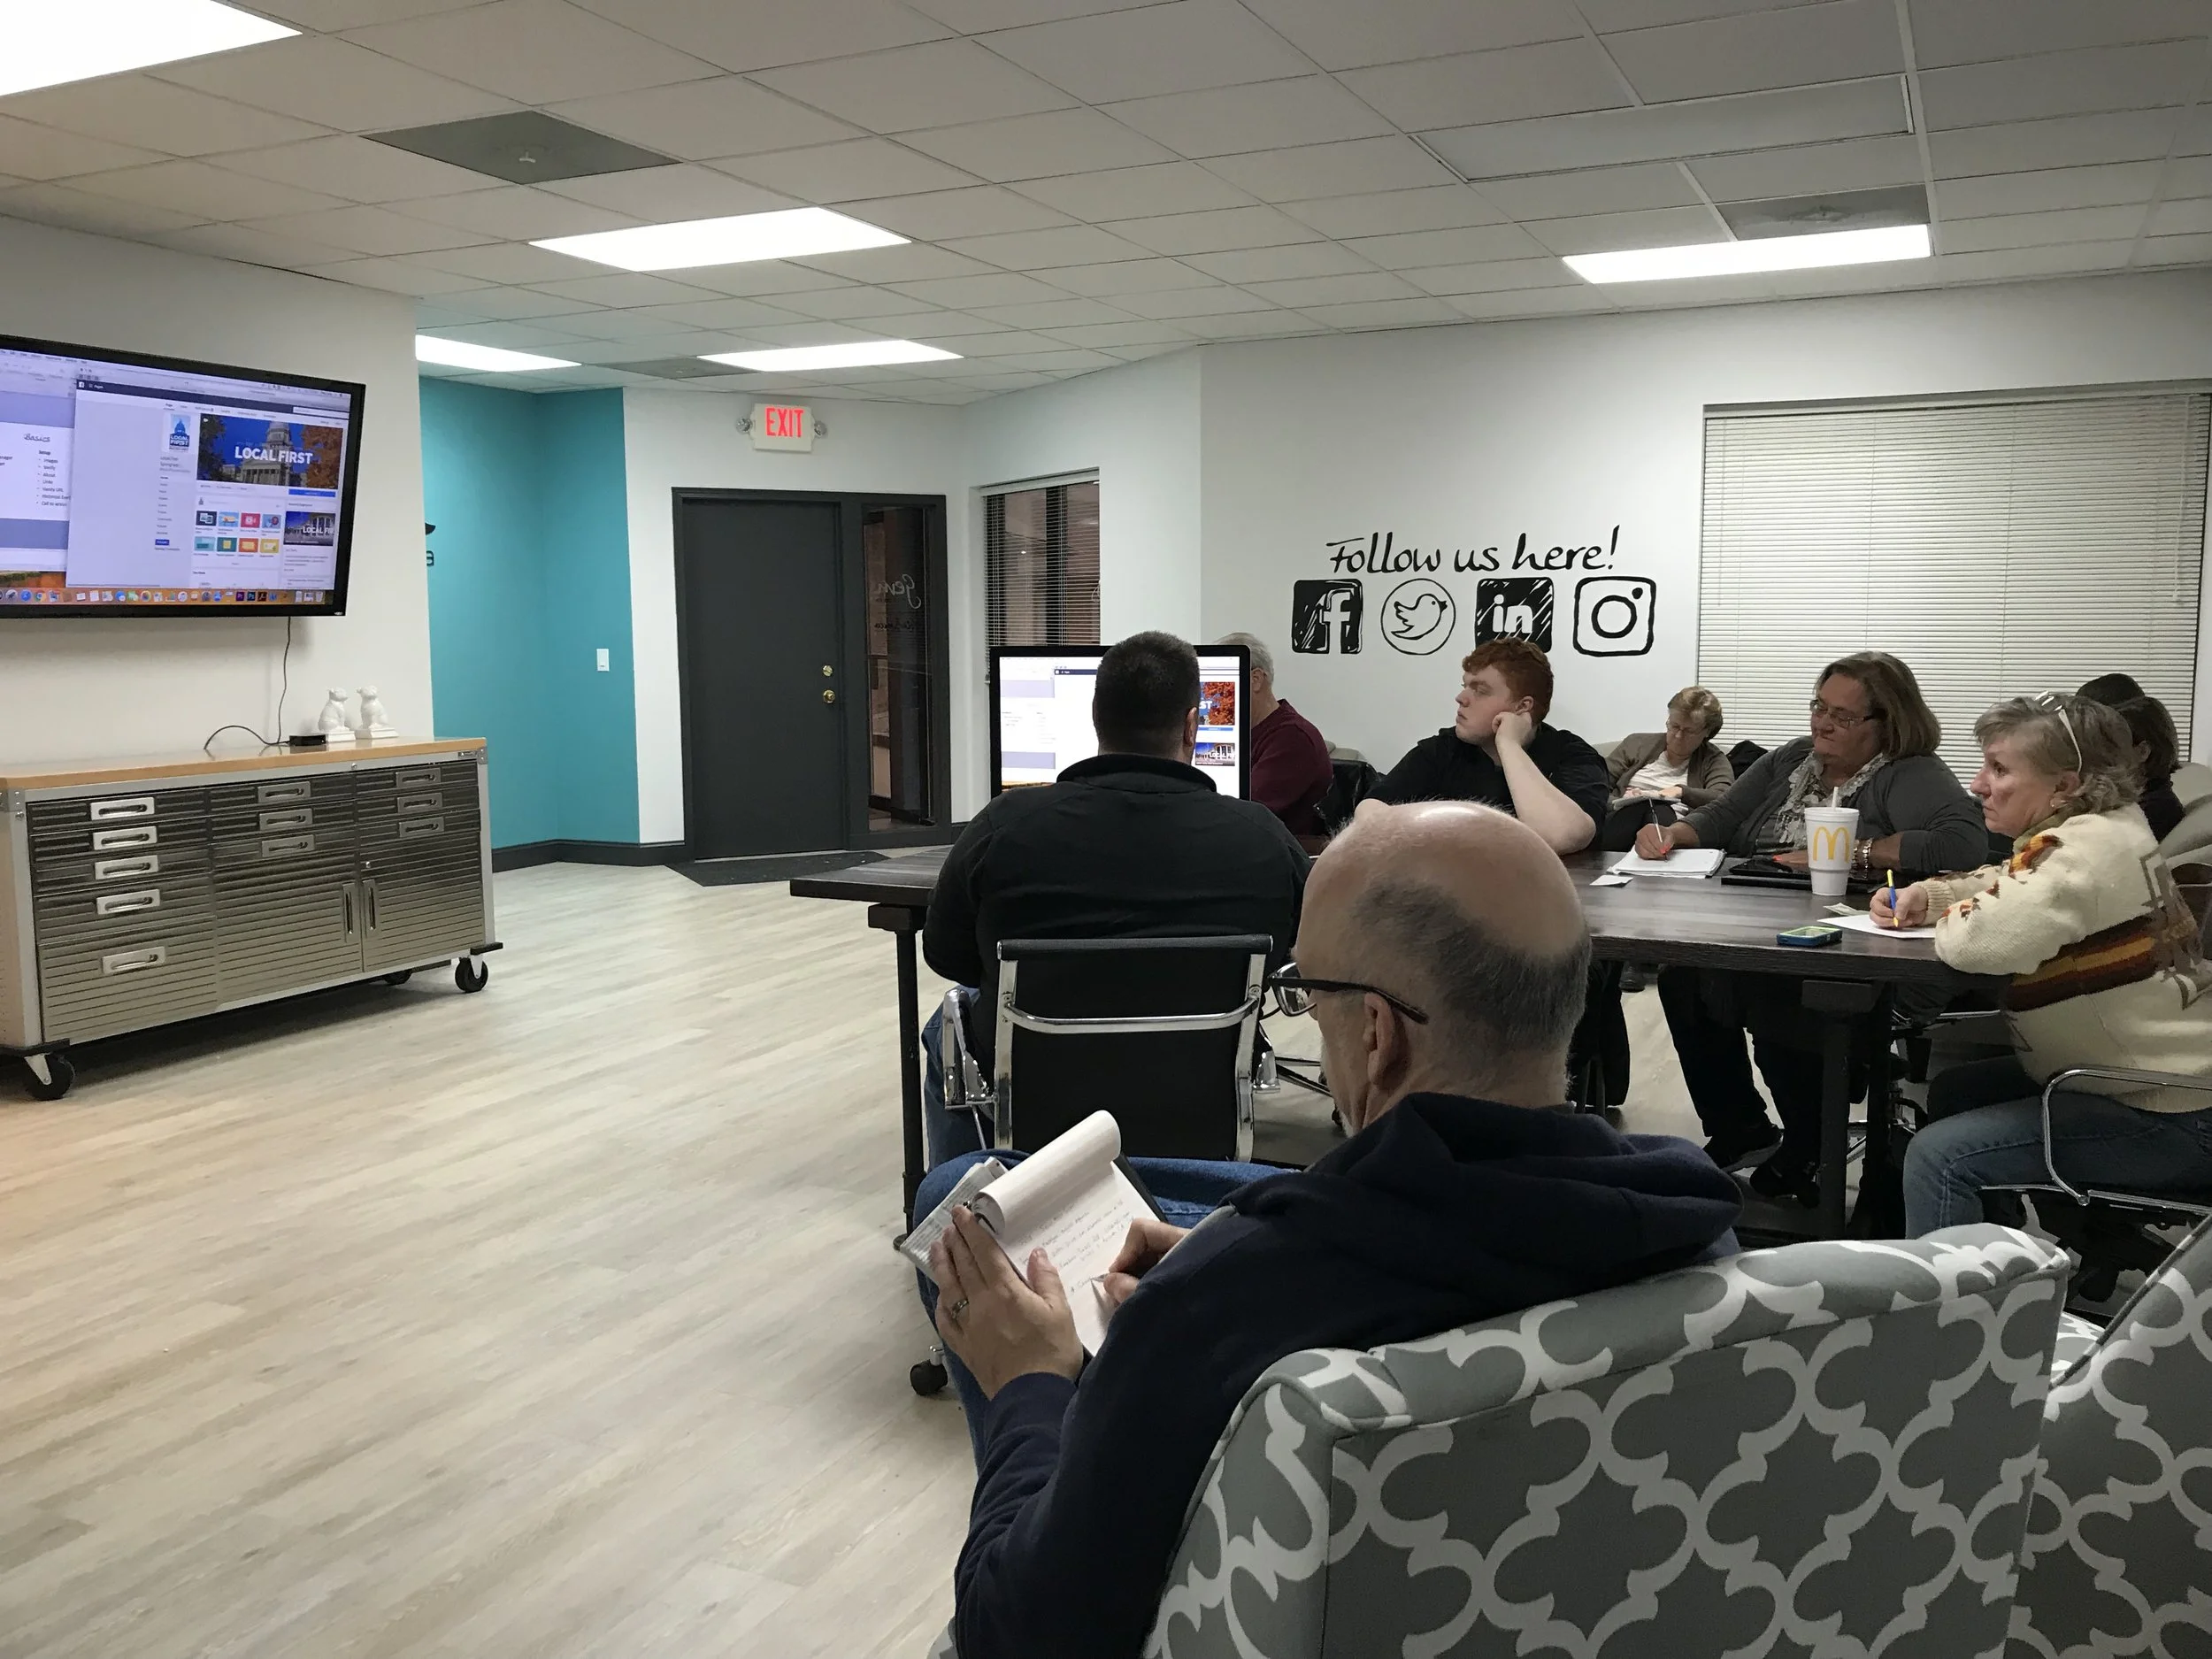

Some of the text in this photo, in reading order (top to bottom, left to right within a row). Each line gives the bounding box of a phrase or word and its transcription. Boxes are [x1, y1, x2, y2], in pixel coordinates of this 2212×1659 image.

[764, 406, 804, 438] EXIT
[234, 446, 313, 465] LOCAL FIRST
[1325, 525, 1620, 573] Follow us here!
